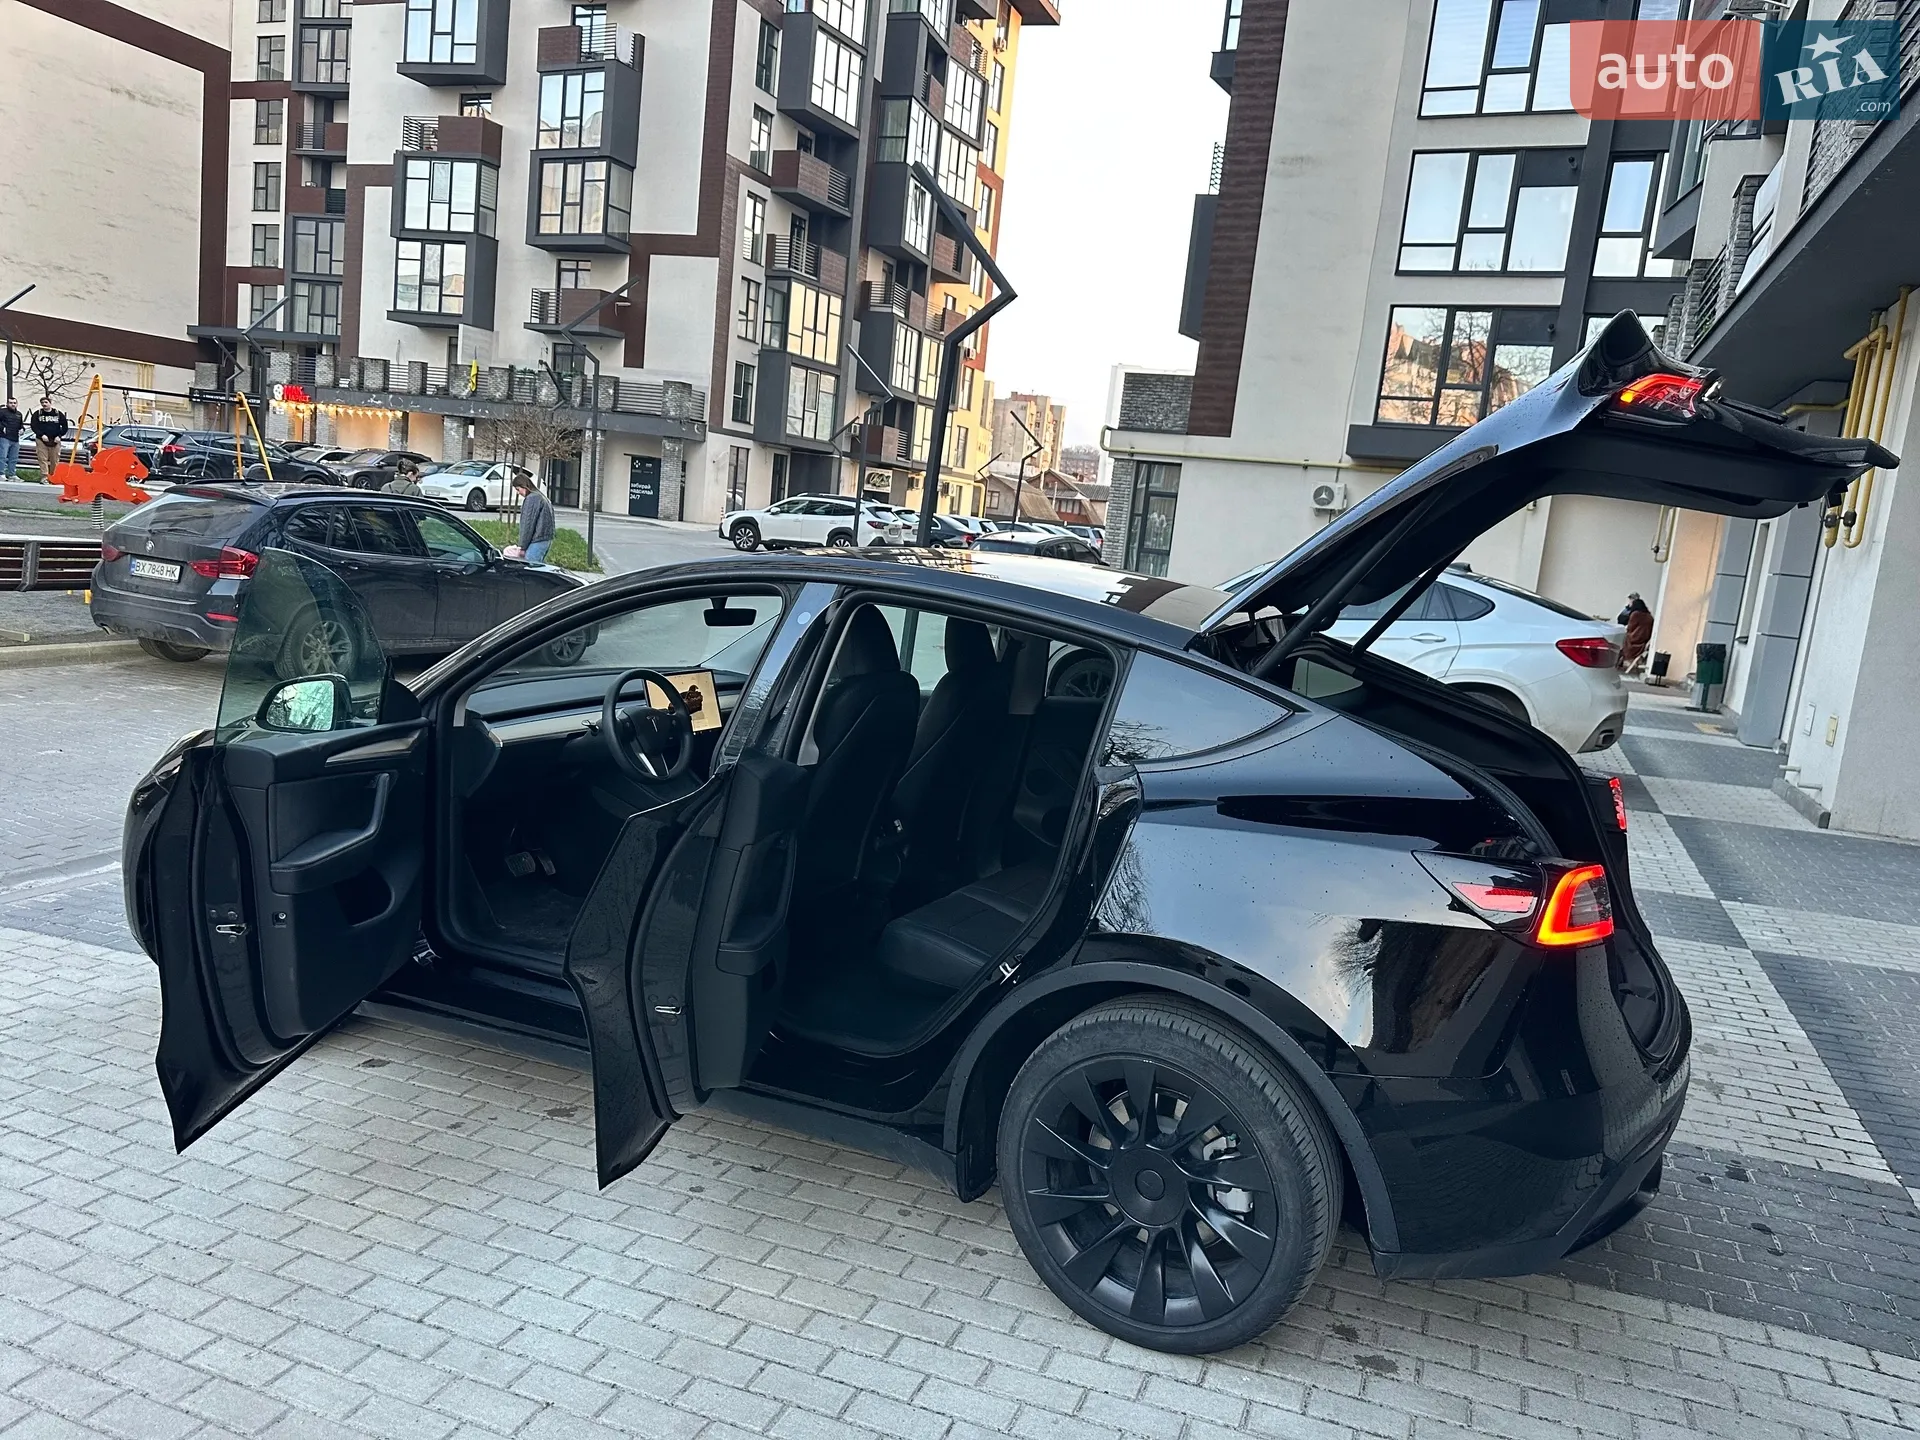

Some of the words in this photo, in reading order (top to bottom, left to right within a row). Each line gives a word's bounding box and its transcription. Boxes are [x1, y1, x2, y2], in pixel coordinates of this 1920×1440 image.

[135, 561, 147, 573] BX
[147, 563, 165, 576] 7848
[165, 566, 178, 578] HK
